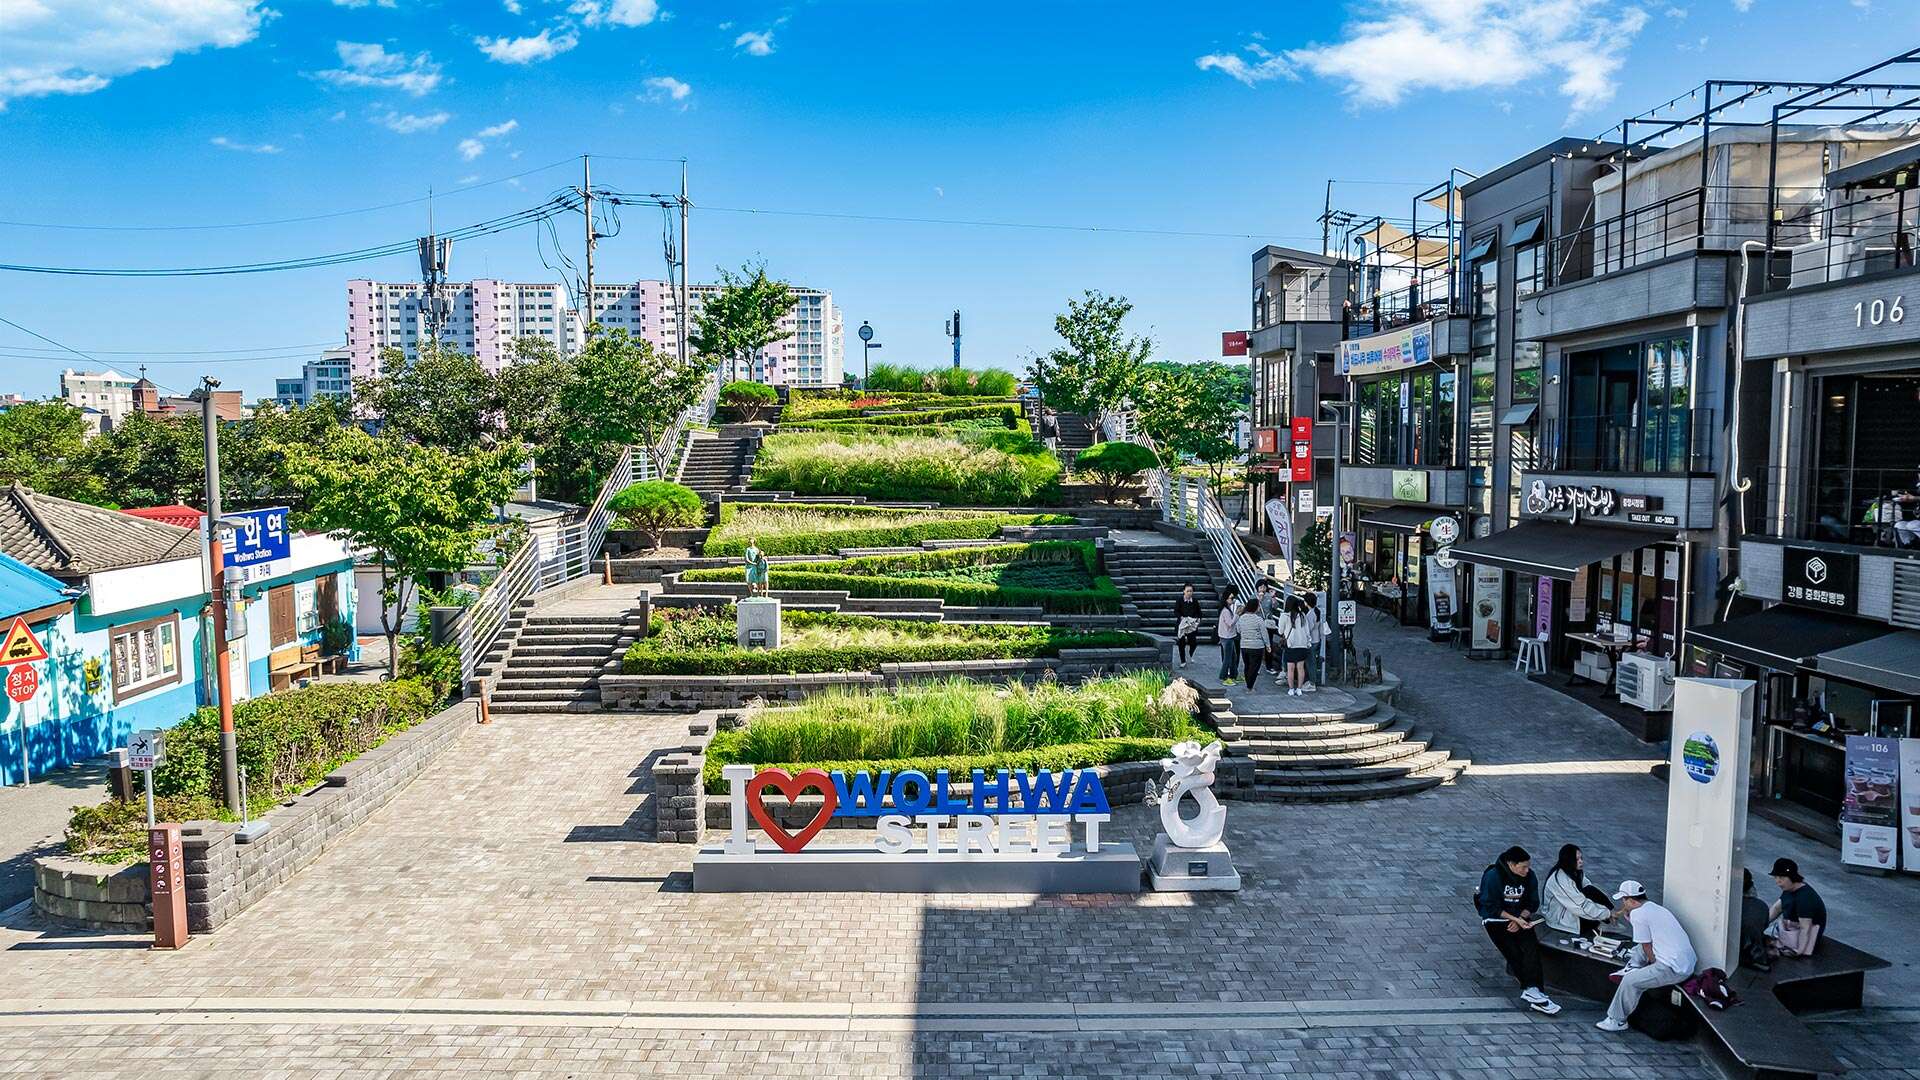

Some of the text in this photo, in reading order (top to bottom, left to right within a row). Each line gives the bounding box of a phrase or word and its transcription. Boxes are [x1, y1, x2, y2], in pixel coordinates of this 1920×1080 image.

[1854, 295, 1904, 328] 106
[234, 549, 272, 563] Wolhwa Station
[1788, 585, 1803, 599] 강릉
[11, 669, 34, 687] 정지
[11, 684, 35, 697] STOP
[1871, 743, 1889, 753] 106
[722, 764, 1110, 856] I WOLHWA
[875, 813, 1111, 856] STREET
